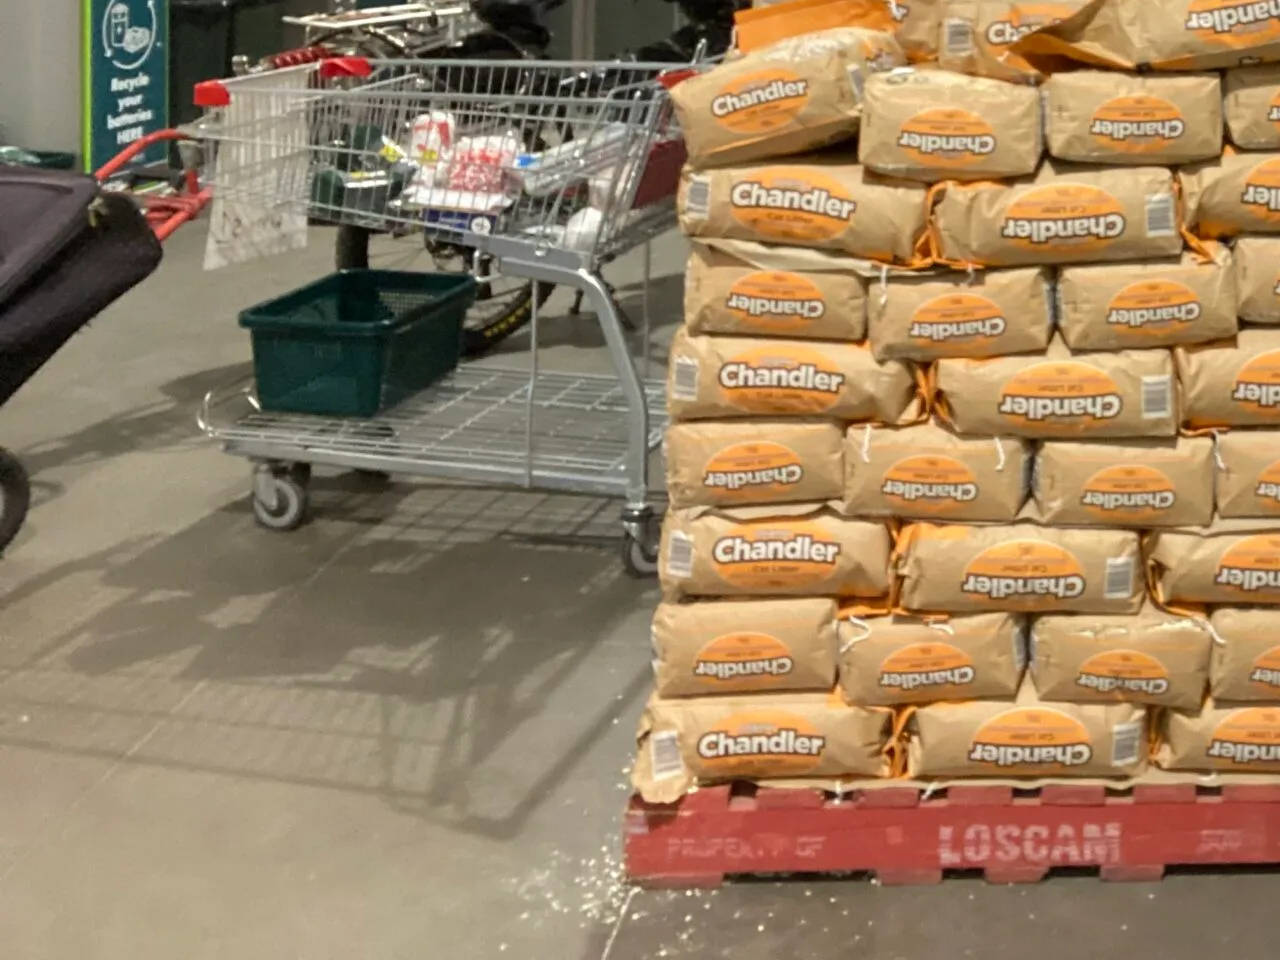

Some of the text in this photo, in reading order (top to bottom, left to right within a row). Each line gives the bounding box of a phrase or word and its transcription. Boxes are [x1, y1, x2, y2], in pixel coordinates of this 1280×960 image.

[111, 72, 150, 92] Recycle
[118, 94, 143, 112] your
[710, 79, 807, 117] Chandler
[107, 109, 153, 129] batteries
[1090, 117, 1183, 139] Chandler
[899, 130, 994, 155] Chandler
[732, 182, 855, 220] Chandler
[1004, 214, 1124, 243] Chandler
[729, 294, 824, 318] Chandler
[1108, 303, 1200, 327] Chandler
[910, 317, 1006, 340] Chandler
[719, 362, 844, 393] Chandler
[1000, 395, 1122, 420] Chandler
[705, 465, 802, 489] Chandler
[883, 480, 977, 501] Chandler
[1082, 491, 1175, 509] Chandler
[713, 536, 840, 564] Chandler
[962, 574, 1085, 598] Chandler
[696, 658, 792, 677] Chandler
[880, 668, 974, 689] Chandler
[1078, 674, 1169, 694] Chandler
[697, 729, 824, 758] Chandler
[970, 743, 1091, 766] Chandler
[938, 822, 1122, 864] LOSCAM
